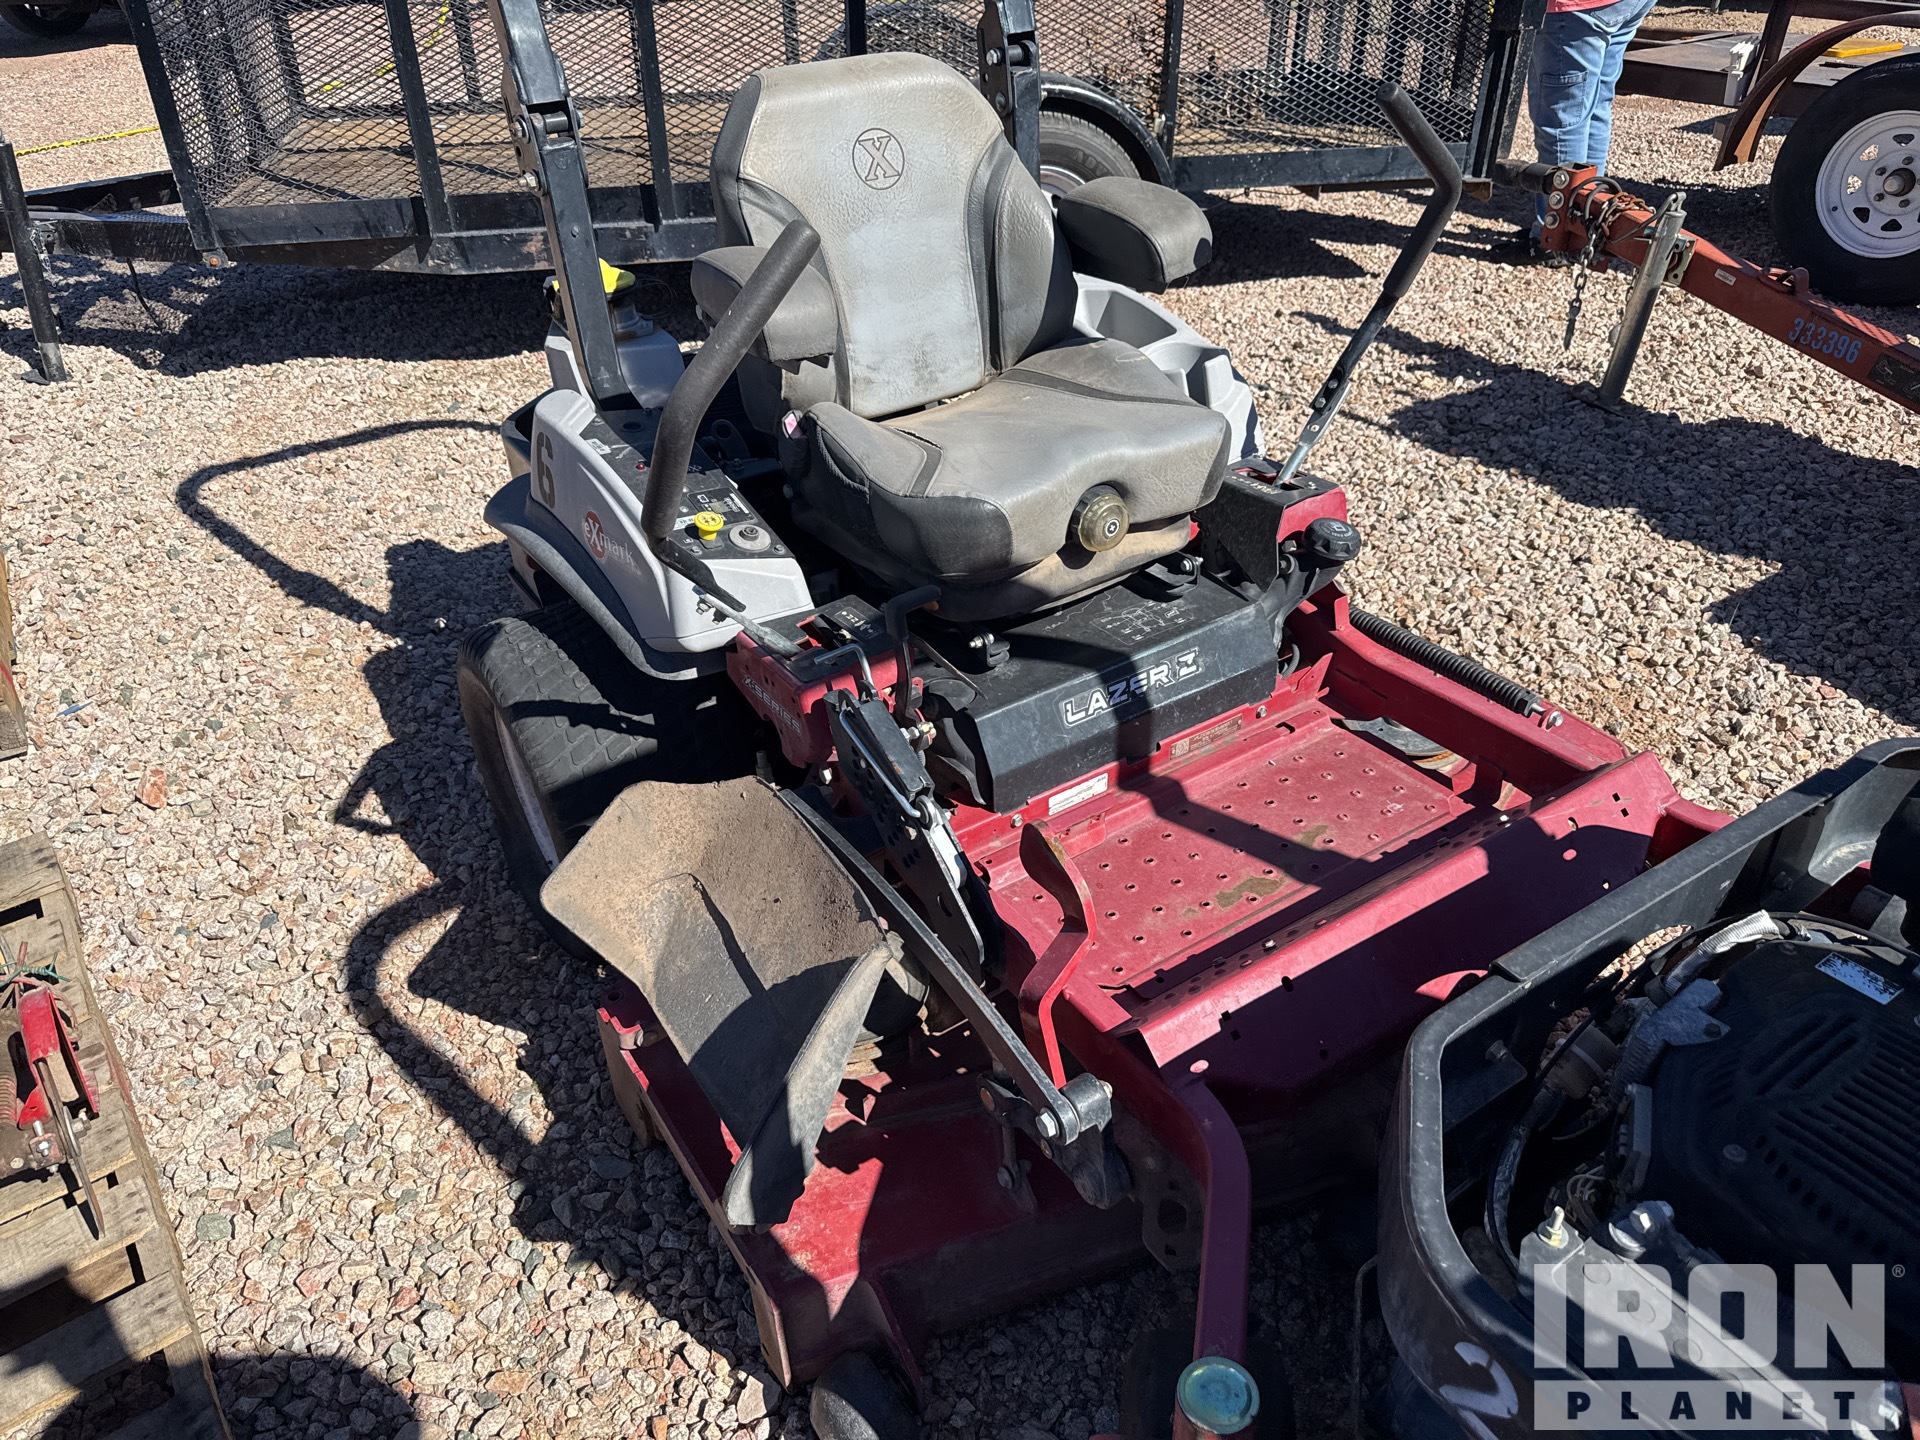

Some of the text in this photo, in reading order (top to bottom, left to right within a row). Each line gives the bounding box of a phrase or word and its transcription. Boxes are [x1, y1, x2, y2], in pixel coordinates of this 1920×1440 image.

[1788, 317, 1862, 364] 333396
[536, 431, 556, 509] 6
[1063, 662, 1173, 728] LAZER
